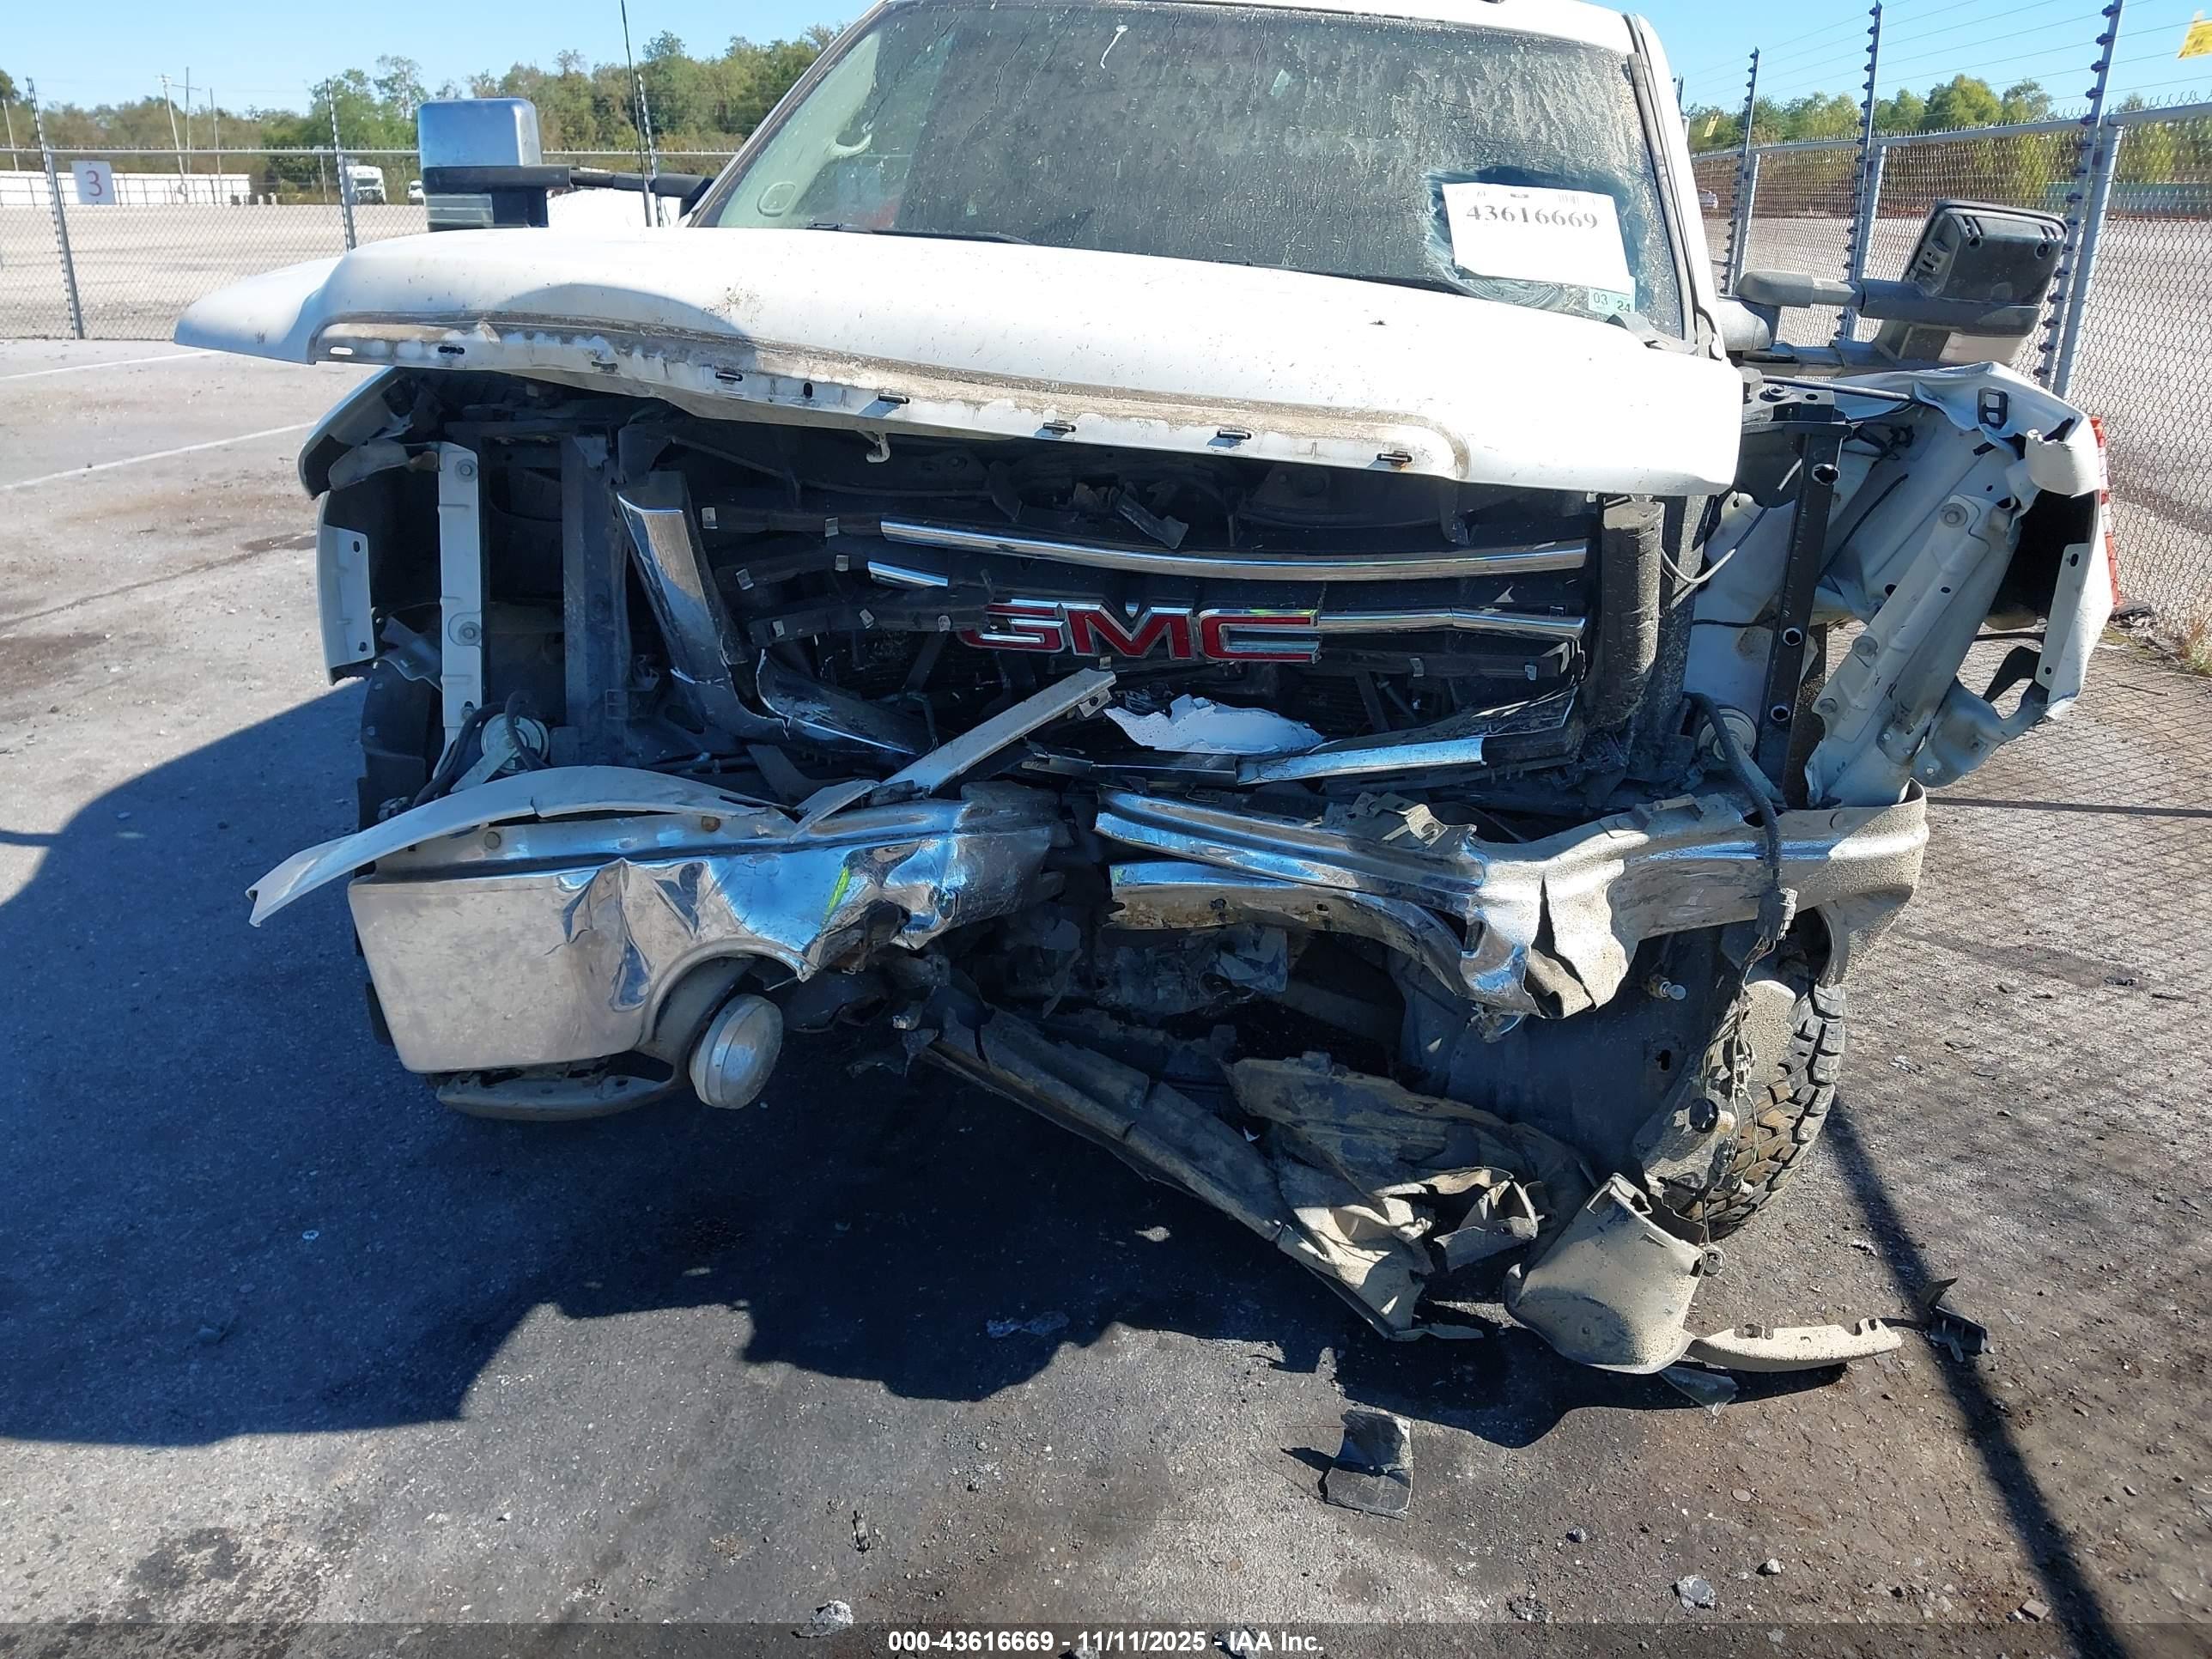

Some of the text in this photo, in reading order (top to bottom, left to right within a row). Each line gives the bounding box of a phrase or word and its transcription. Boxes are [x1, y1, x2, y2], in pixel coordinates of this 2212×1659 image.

[85, 170, 103, 198] 3
[1466, 204, 1599, 229] 43616669
[957, 597, 1322, 665] GMC
